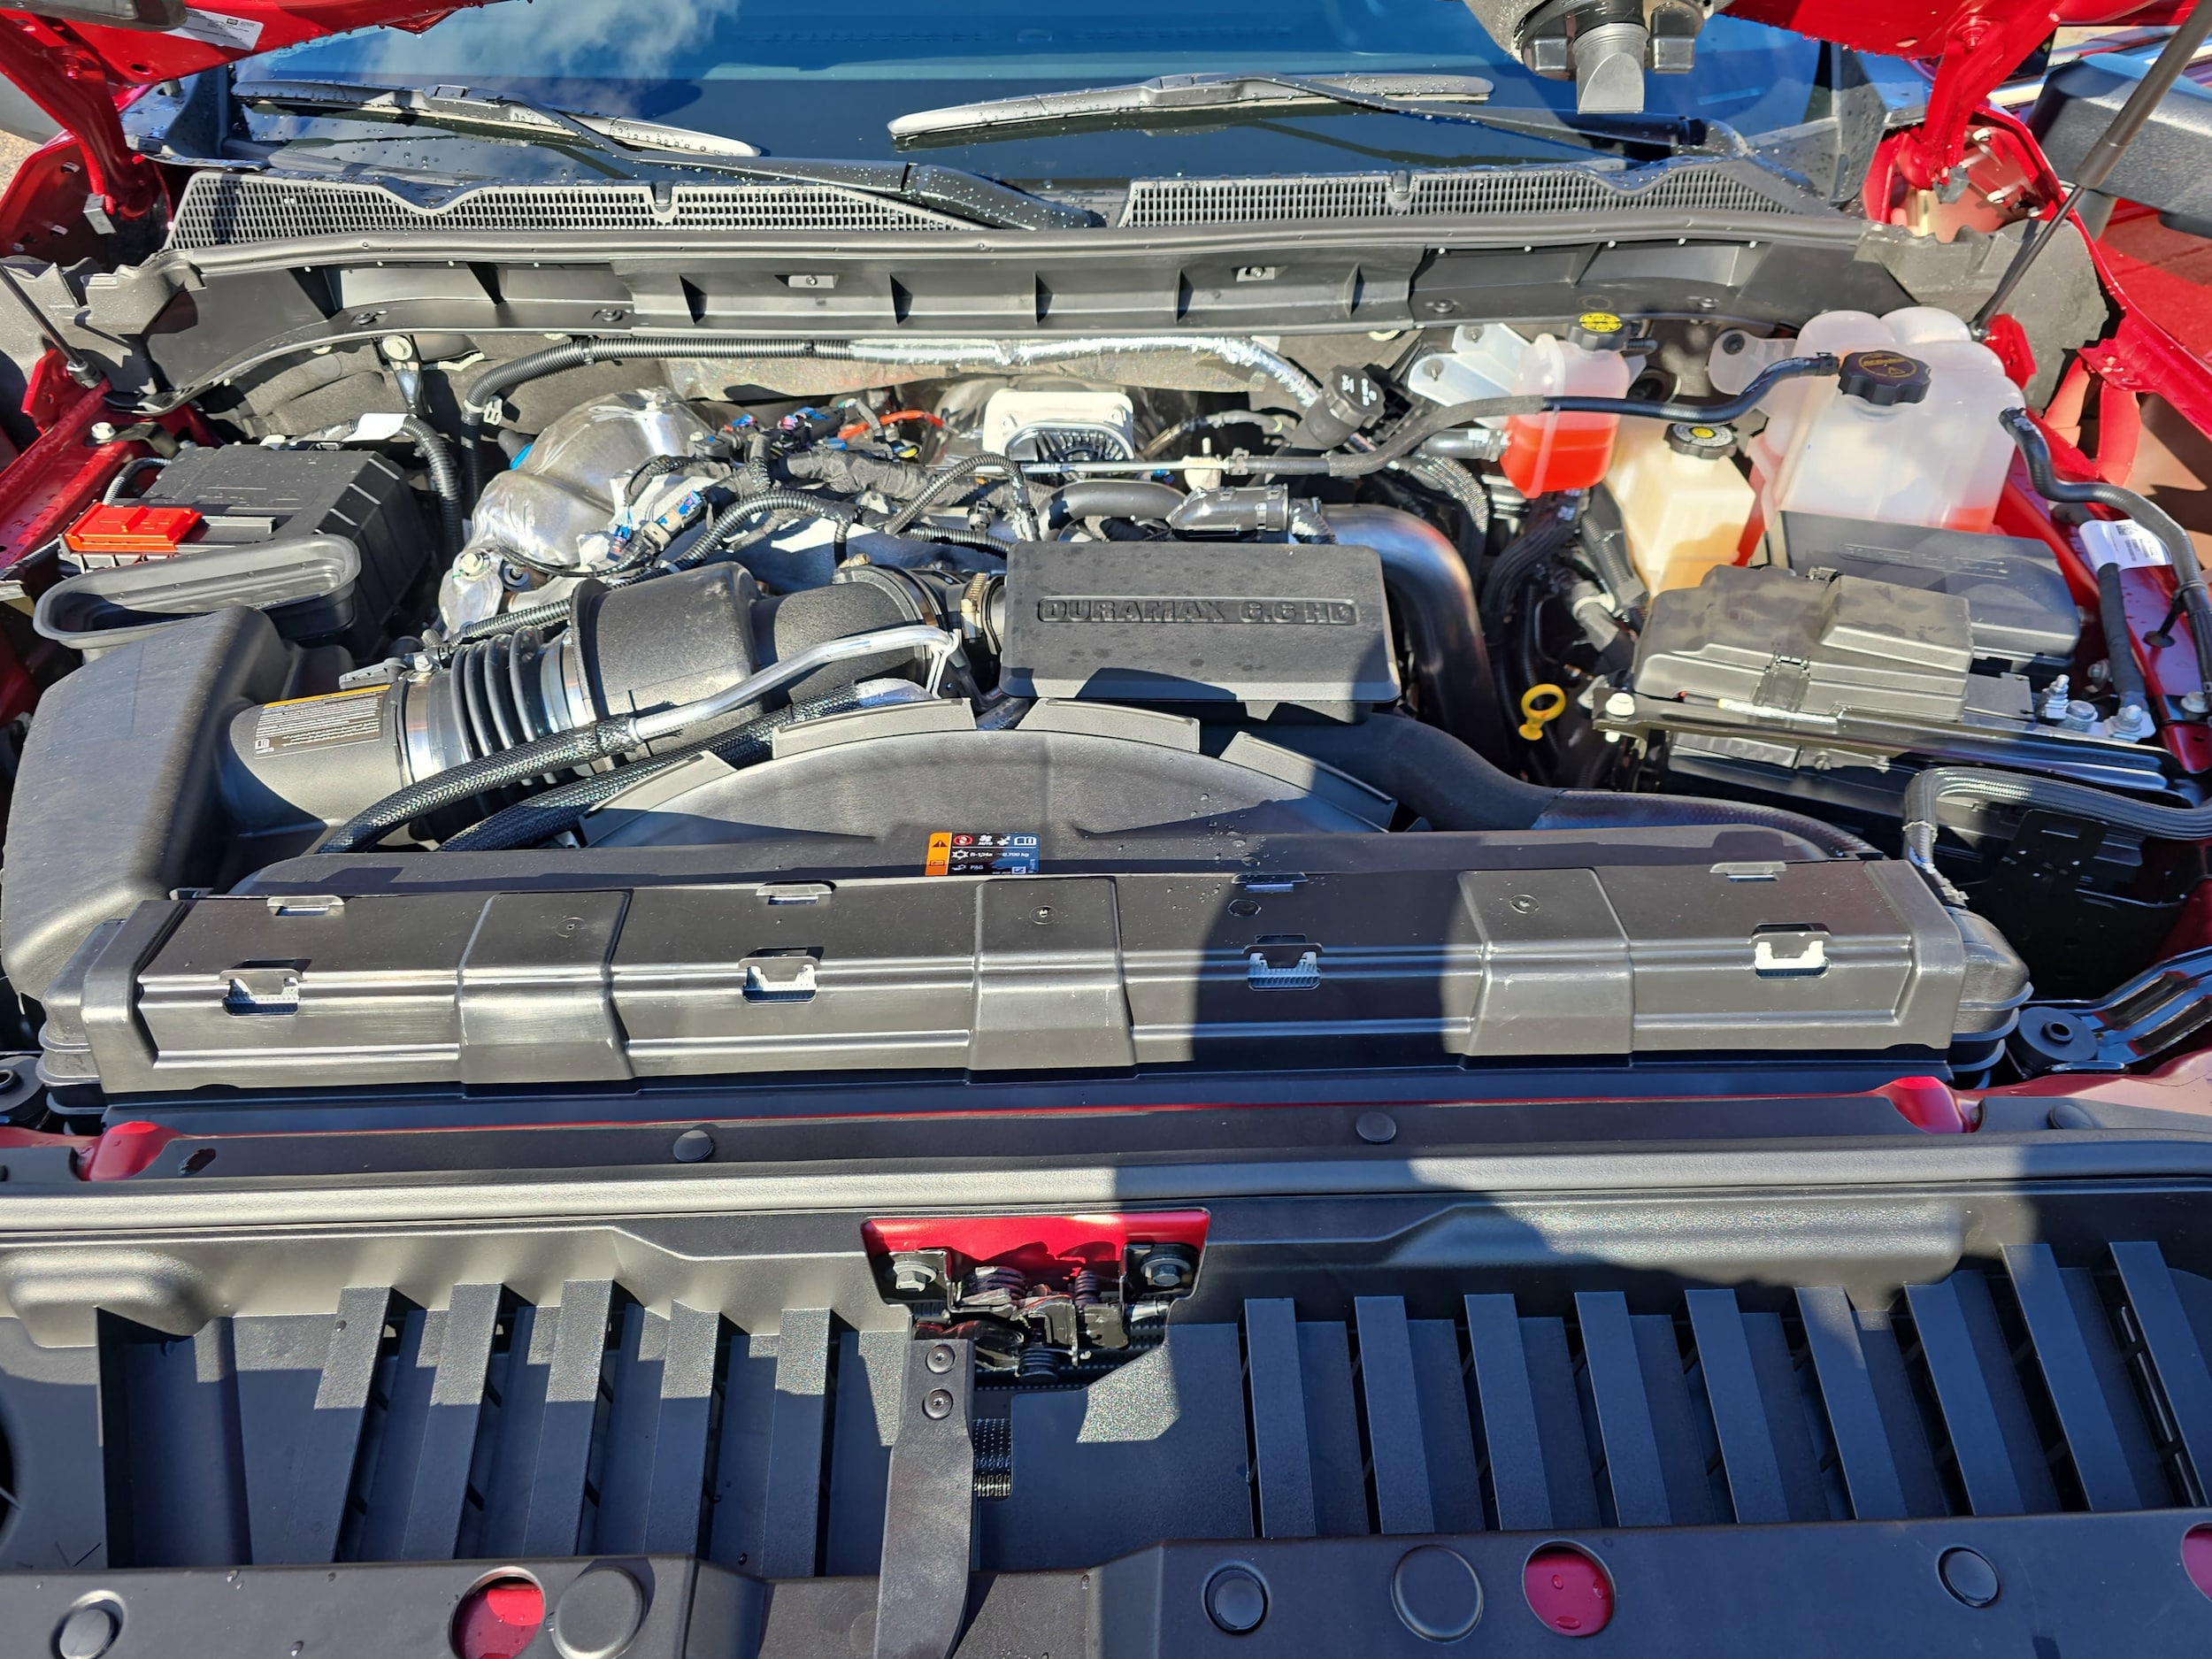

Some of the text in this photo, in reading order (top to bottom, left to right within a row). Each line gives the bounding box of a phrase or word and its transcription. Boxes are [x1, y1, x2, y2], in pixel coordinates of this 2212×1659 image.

[1040, 600, 1356, 625] DURAMAX 6.6 HD
